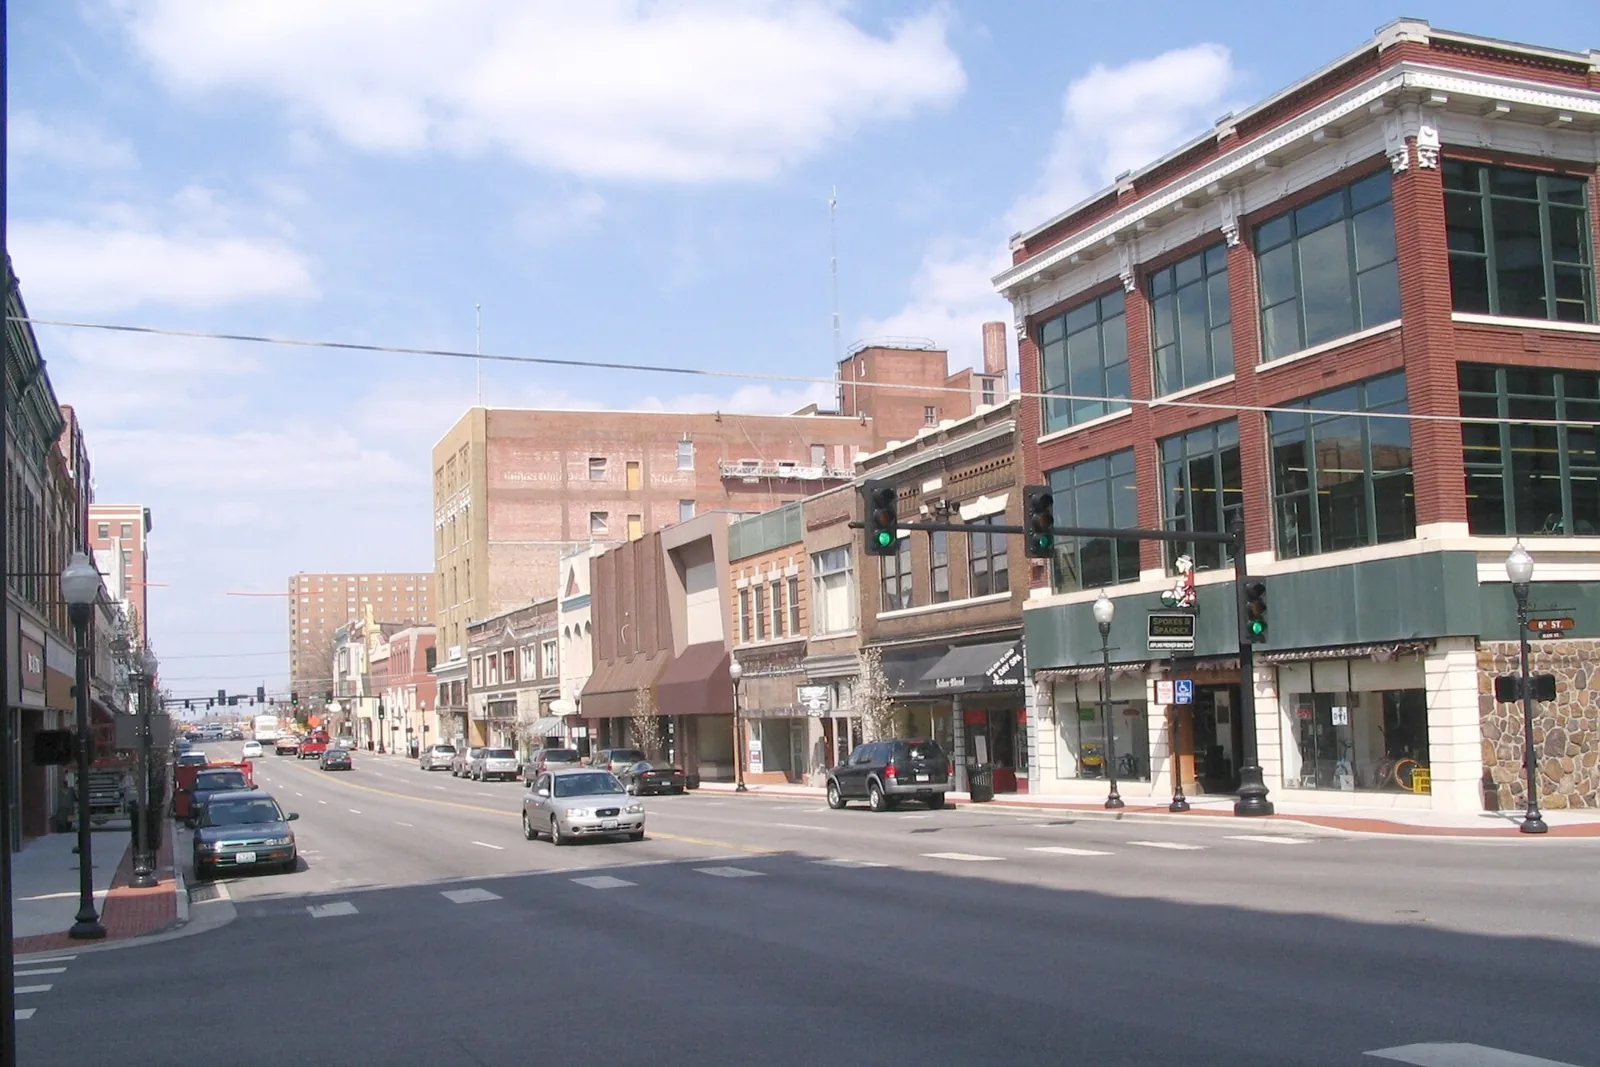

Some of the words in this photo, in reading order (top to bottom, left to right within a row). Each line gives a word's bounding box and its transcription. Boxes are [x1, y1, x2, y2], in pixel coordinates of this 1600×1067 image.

[1153, 626, 1189, 635] SPANDEX
[1551, 620, 1564, 629] ST.
[985, 661, 1001, 677] SALON
[997, 662, 1010, 676] DAY
[1009, 653, 1022, 667] SPA
